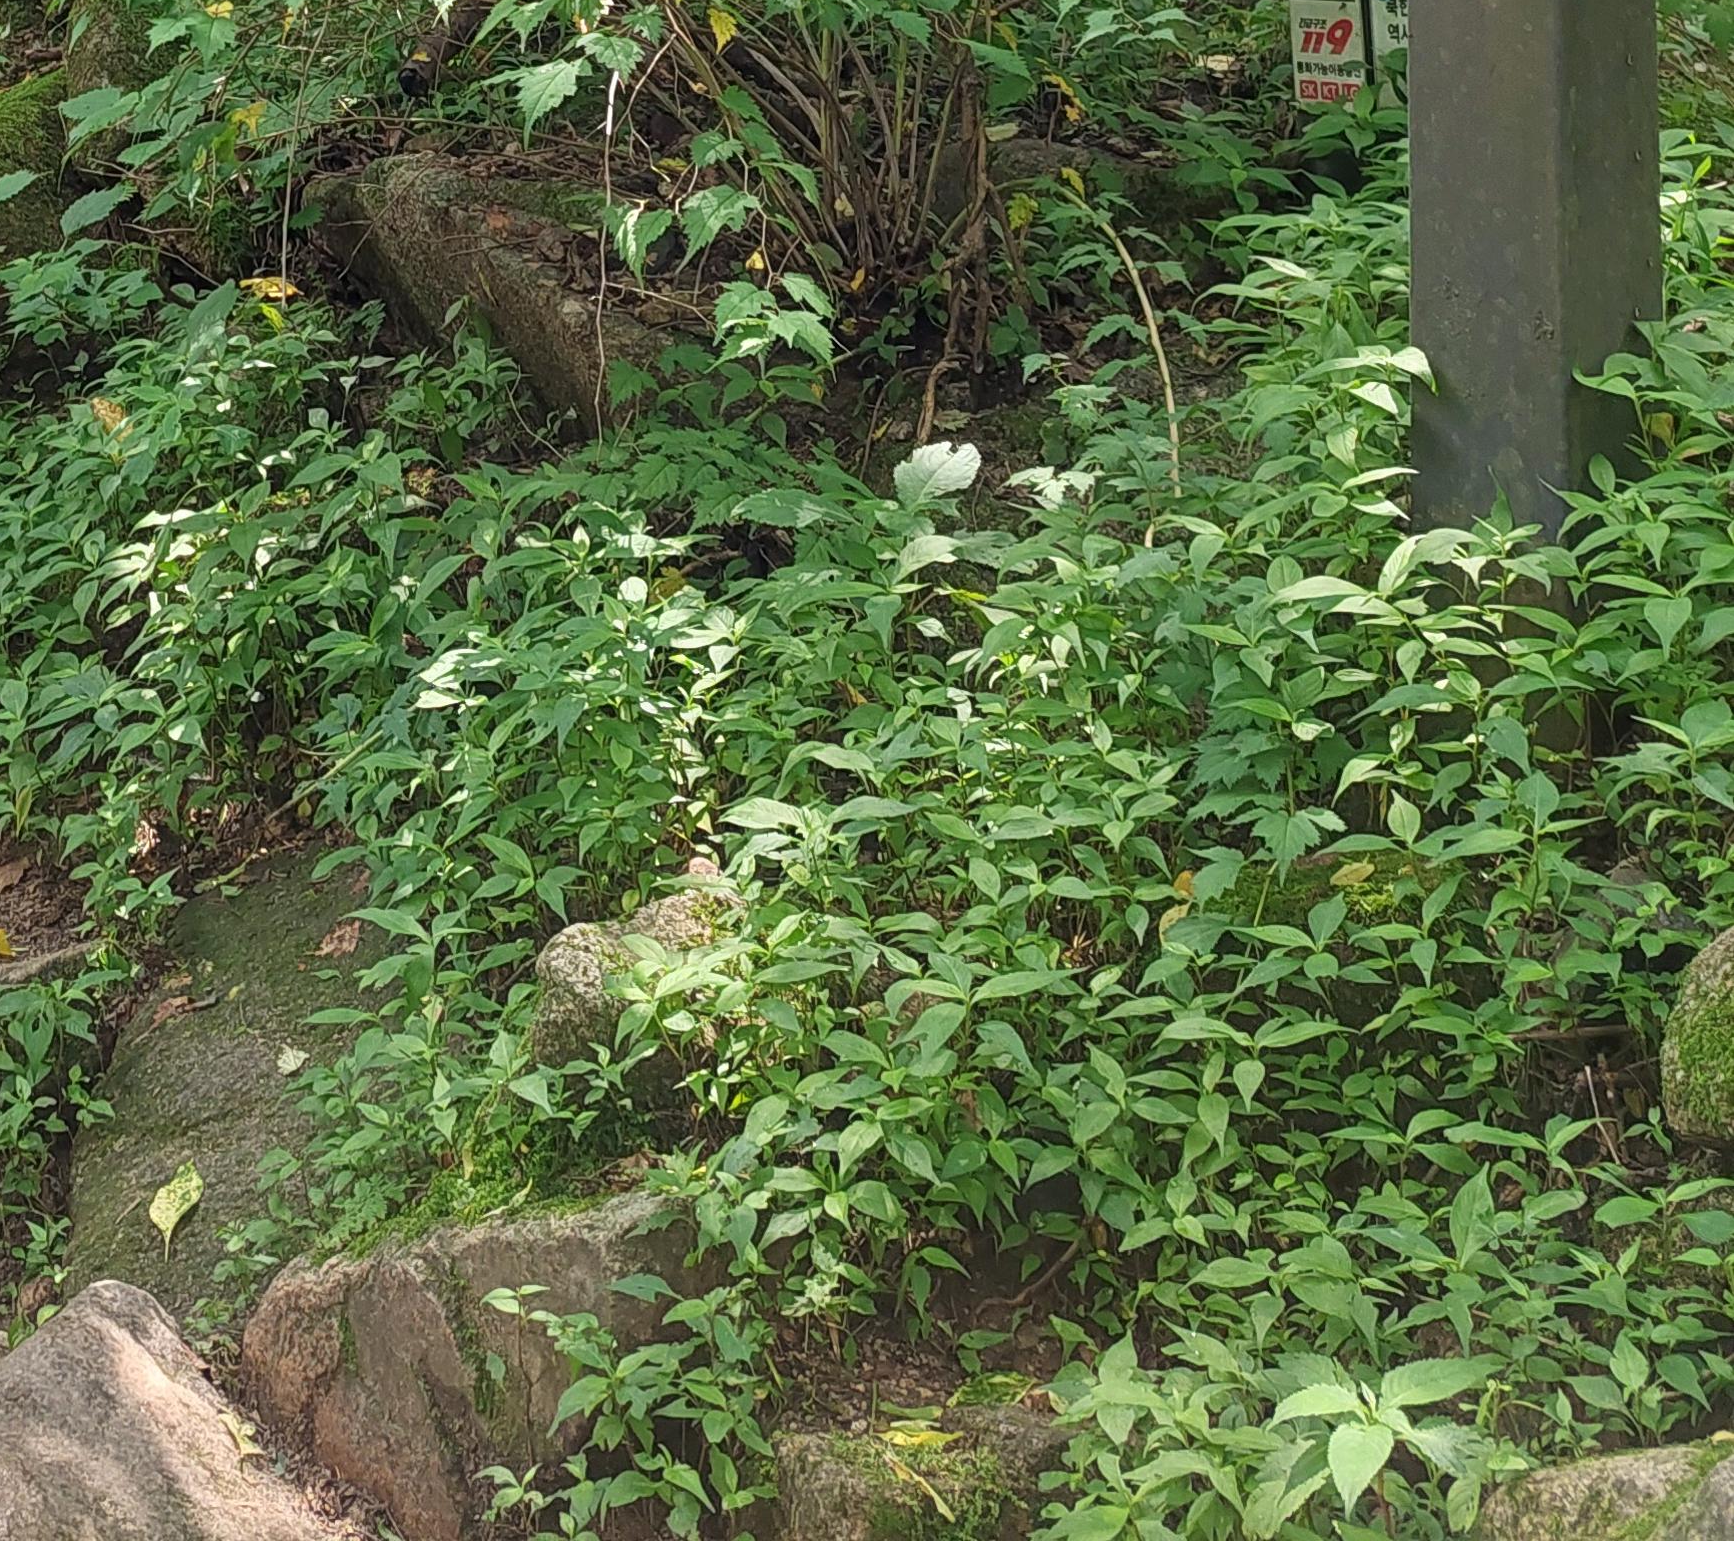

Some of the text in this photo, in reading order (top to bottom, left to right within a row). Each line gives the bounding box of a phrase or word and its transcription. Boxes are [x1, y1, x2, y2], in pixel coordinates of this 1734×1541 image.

[1299, 18, 1327, 30] 긴급구조
[1300, 19, 1353, 55] 119
[1301, 83, 1316, 97] SK
[1322, 84, 1337, 100] KT
